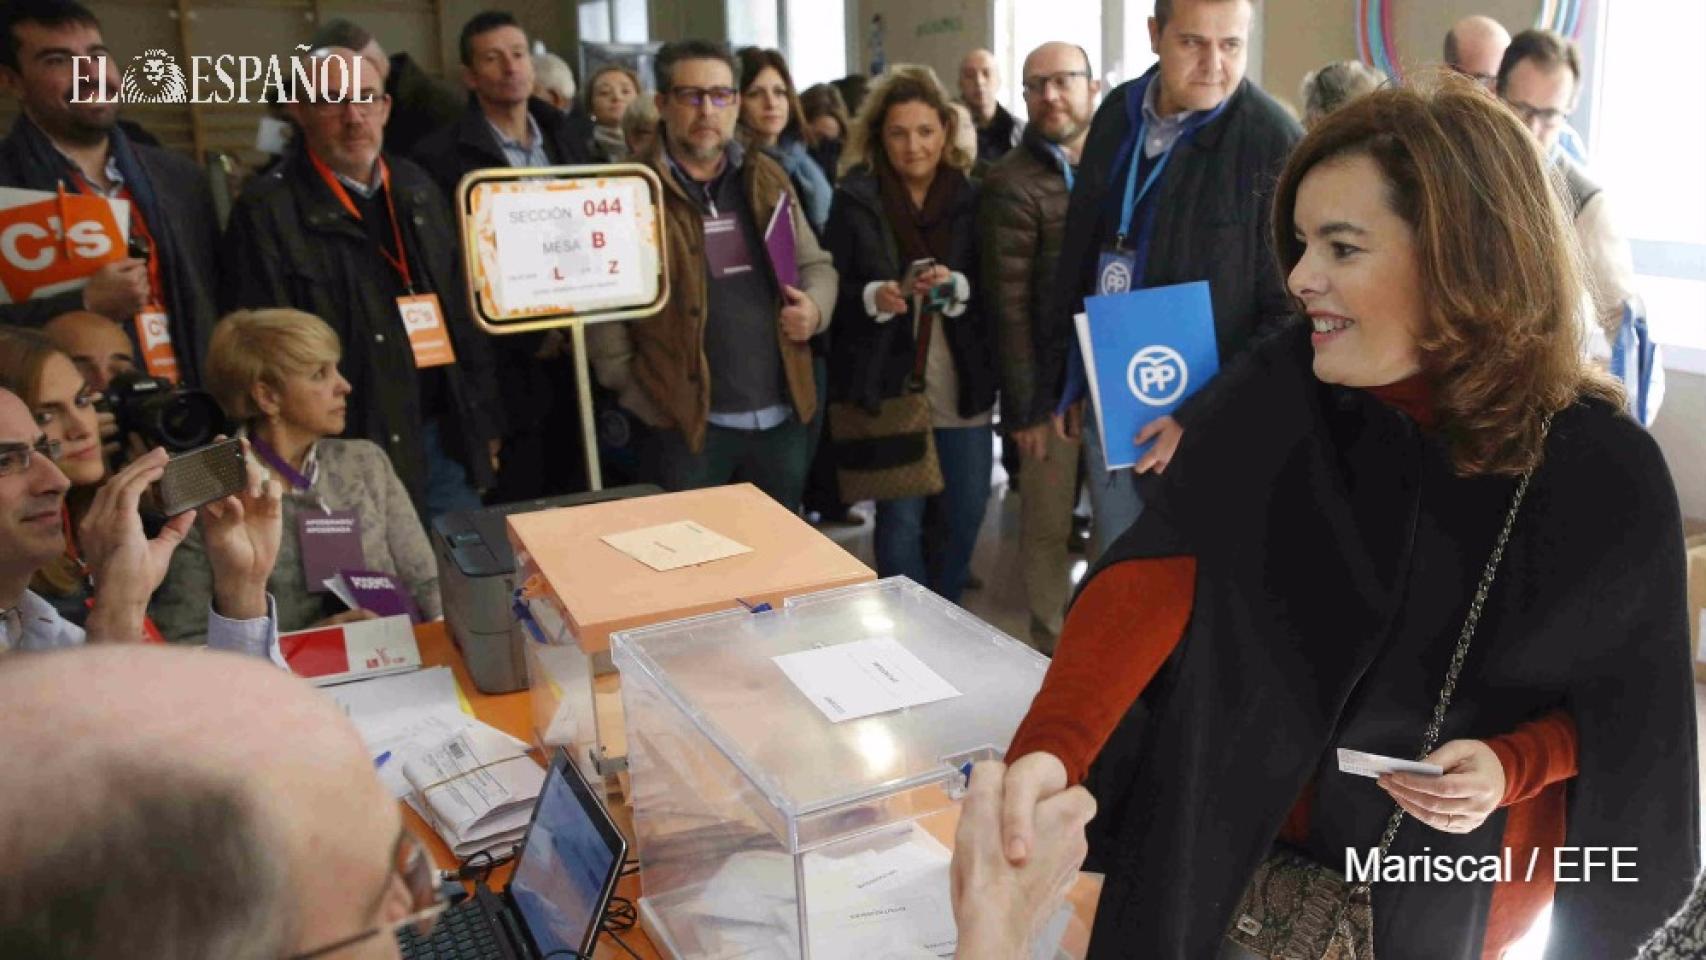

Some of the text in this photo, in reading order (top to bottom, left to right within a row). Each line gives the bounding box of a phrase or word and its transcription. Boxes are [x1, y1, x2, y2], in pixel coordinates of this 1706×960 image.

[508, 197, 623, 225] SECCIÓN 044
[0, 216, 113, 272] C's
[542, 231, 607, 255] MESA B
[552, 266, 565, 281] L
[608, 260, 620, 275] Z
[1139, 363, 1176, 394] PP
